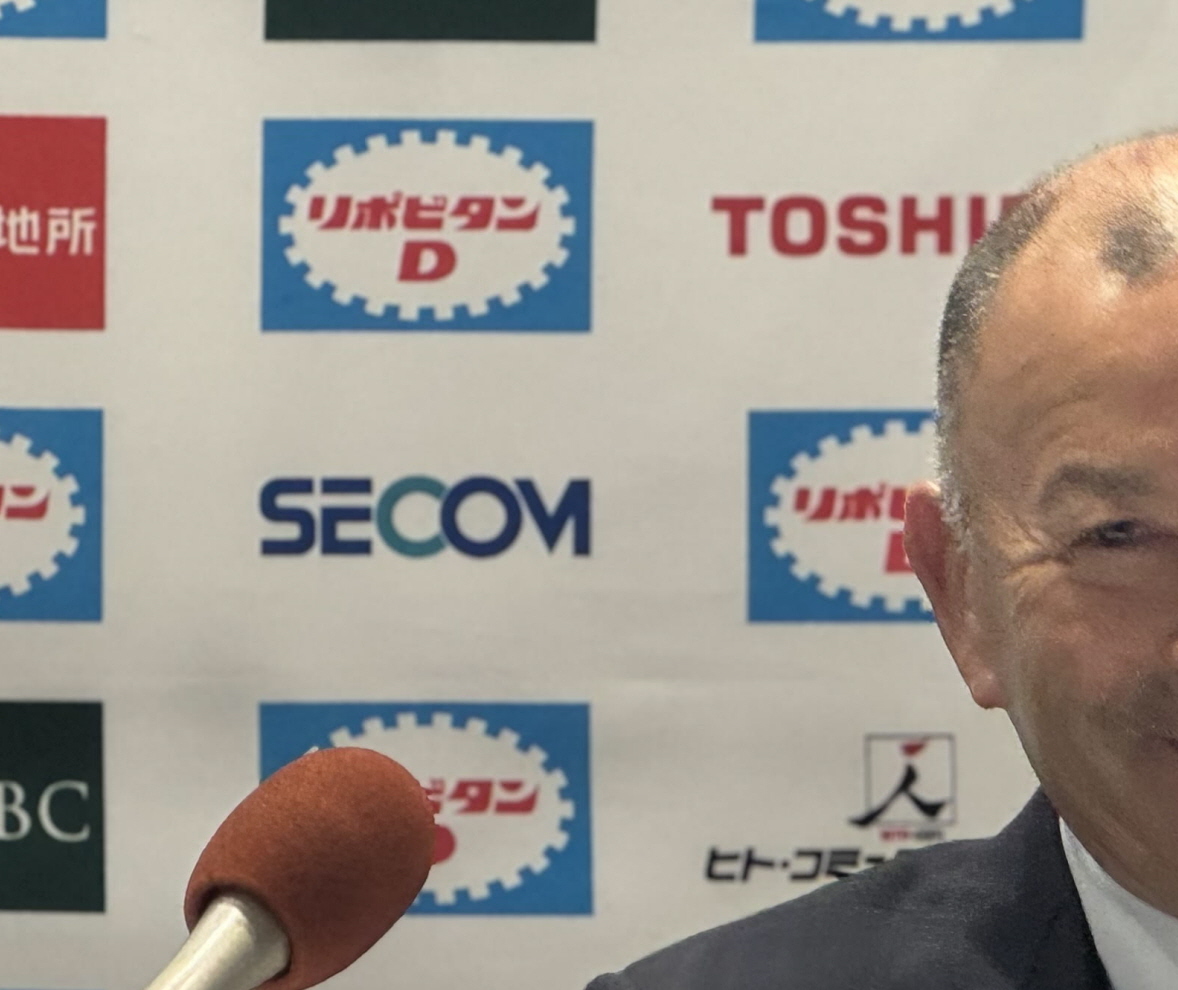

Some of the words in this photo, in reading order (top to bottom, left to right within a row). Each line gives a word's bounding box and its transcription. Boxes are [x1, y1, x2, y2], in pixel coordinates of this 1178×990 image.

[308, 191, 541, 231] リポビタン
[712, 195, 1027, 257] TOSHI
[398, 240, 457, 282] D
[260, 477, 591, 558] SECOM
